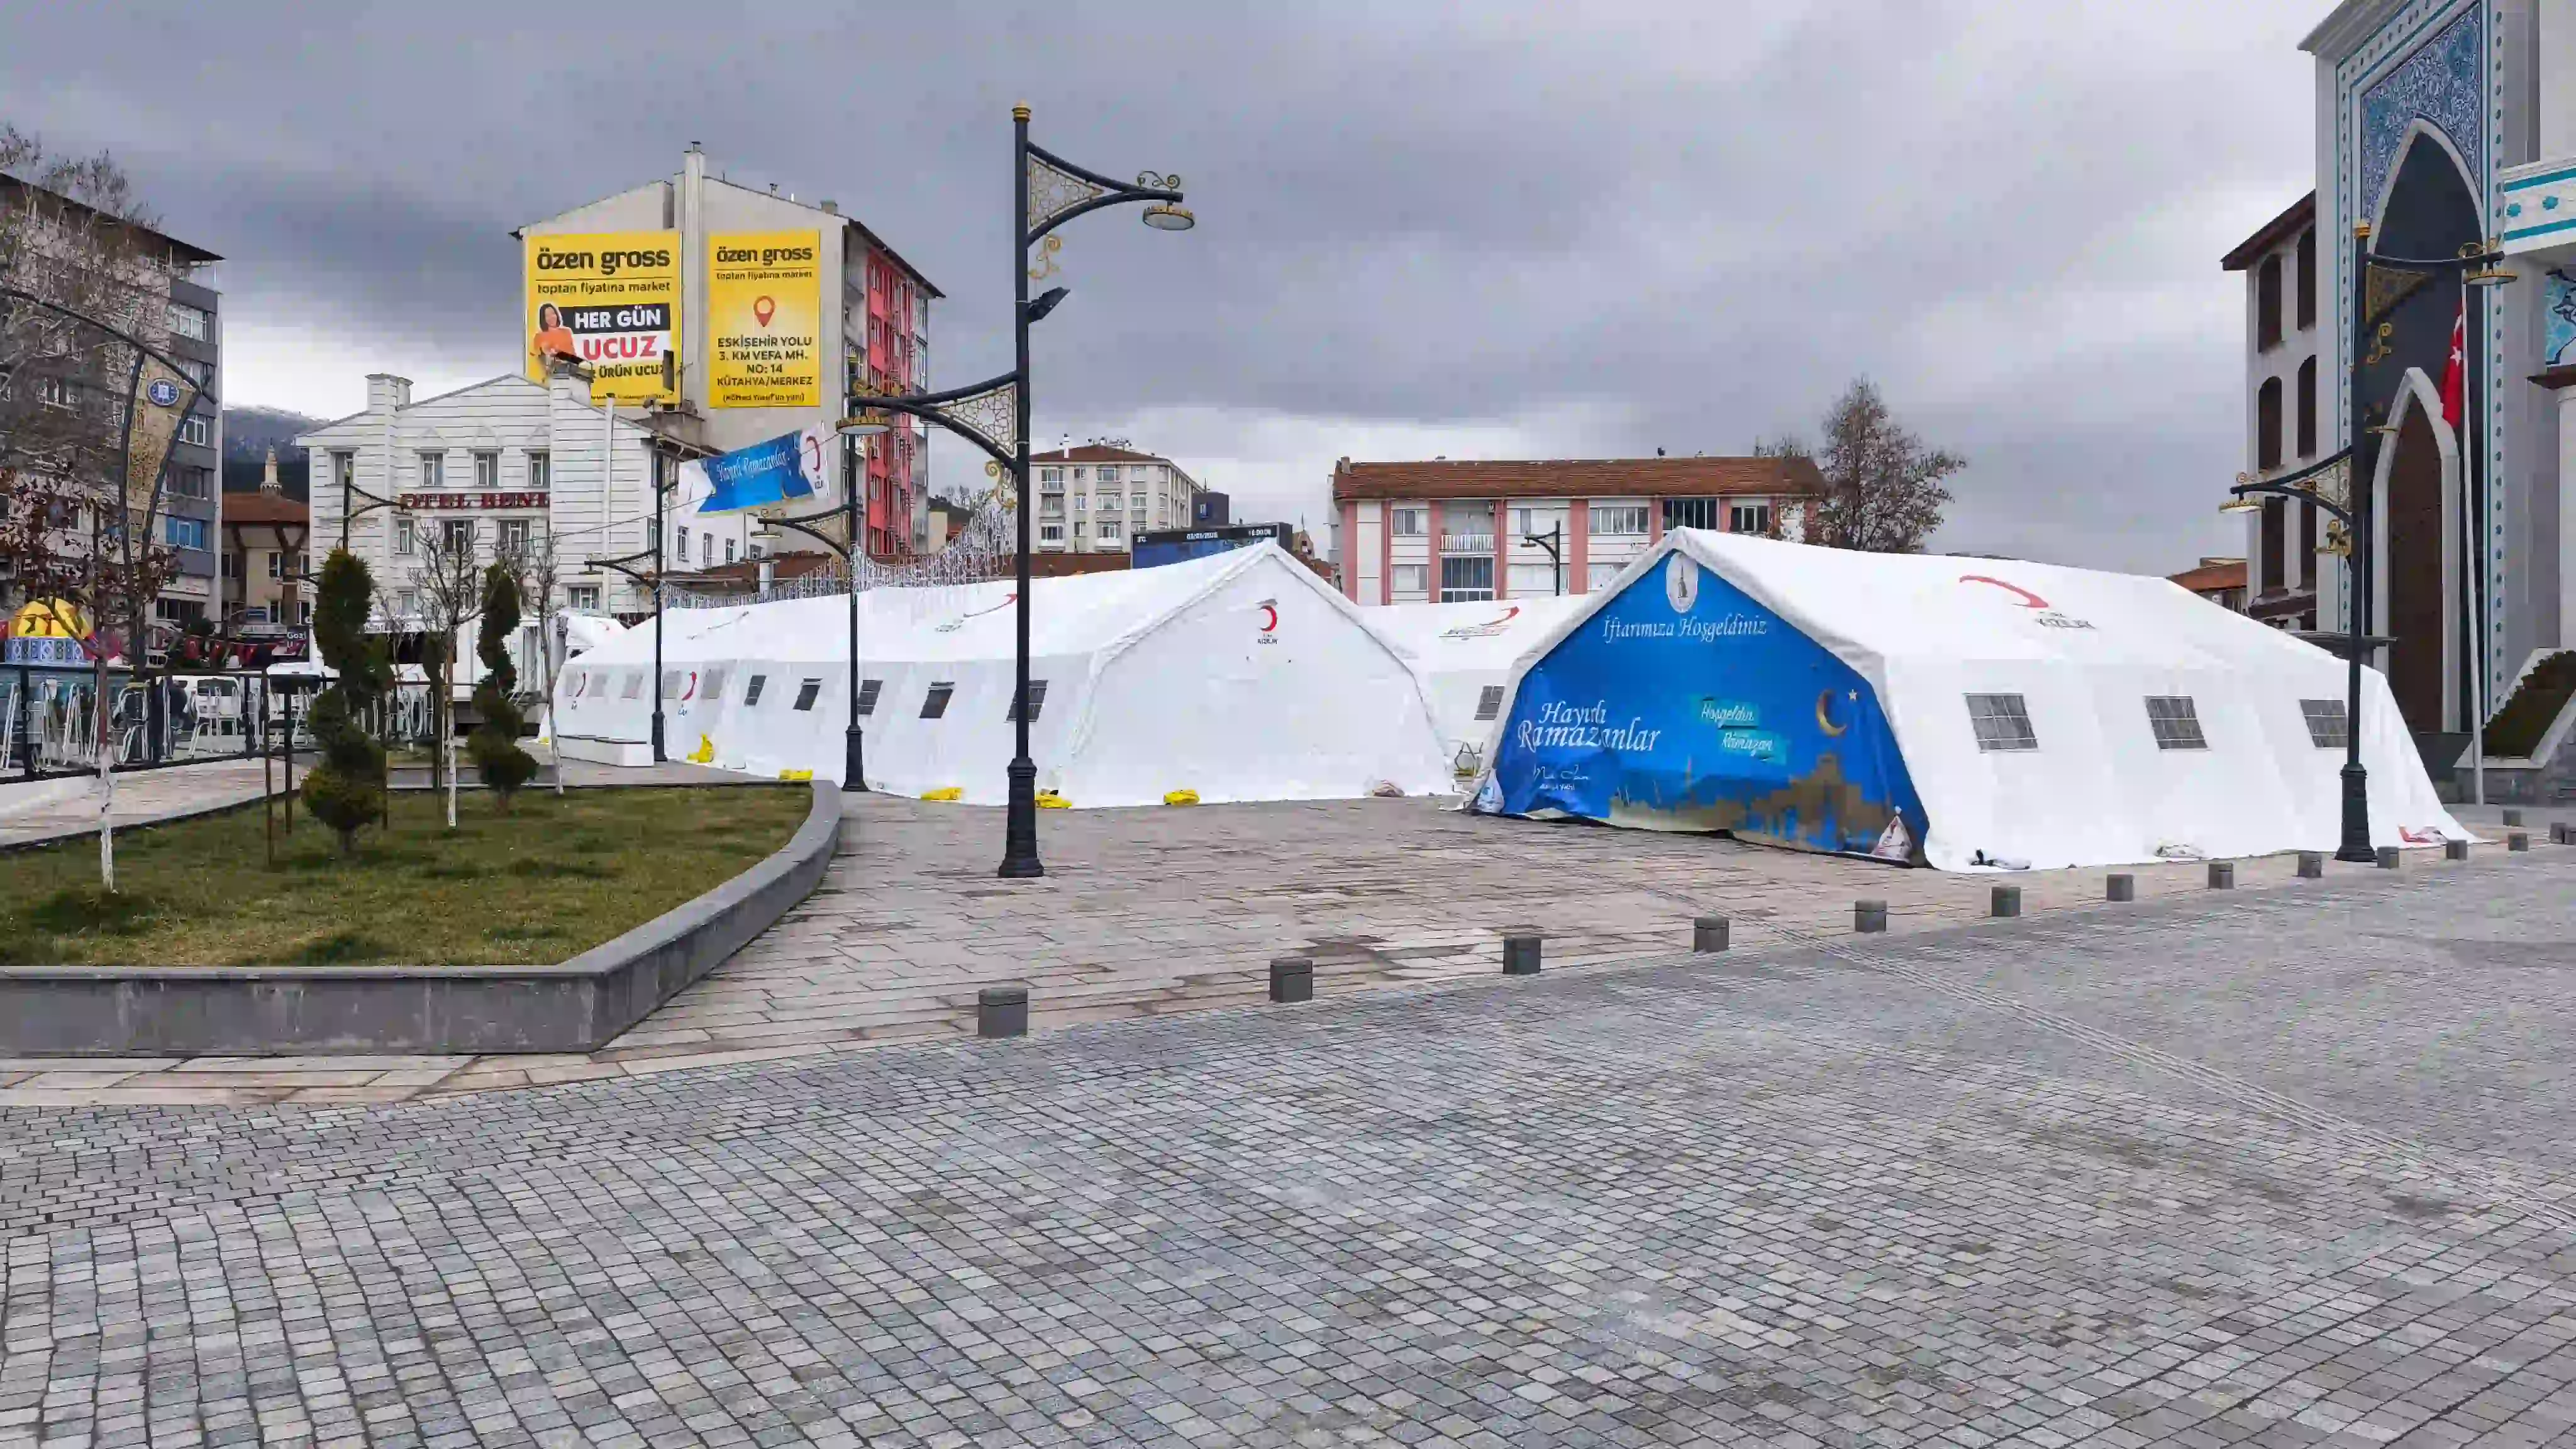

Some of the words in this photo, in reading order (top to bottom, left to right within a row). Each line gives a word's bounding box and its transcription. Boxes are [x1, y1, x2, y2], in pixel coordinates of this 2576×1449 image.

[537, 246, 594, 270] özen
[601, 250, 670, 275] gross
[716, 246, 758, 262] özen
[762, 248, 813, 266] gross
[538, 283, 576, 294] toptan
[581, 282, 625, 294] fiyatına
[629, 280, 670, 292] market
[575, 312, 611, 329] HER
[617, 305, 660, 327] GÜN
[584, 335, 657, 360] UCUZ
[718, 334, 777, 350] ESKİŞEHİR
[780, 336, 813, 347] YOLU
[719, 351, 729, 361] 3.
[733, 351, 750, 360] KM
[753, 350, 782, 360] VEFA
[786, 349, 809, 360] MH.
[599, 364, 631, 379] ÜRÜN
[747, 364, 768, 374] NO:
[770, 364, 782, 374] 14
[717, 375, 813, 387] KÜTAHYA/MERKEZ
[1603, 614, 1674, 644] İftarımıza
[1677, 613, 1767, 642] Hoşgeldiniz
[1538, 699, 1607, 728] Hayırlı
[1518, 717, 1661, 753] Ramazanlar
